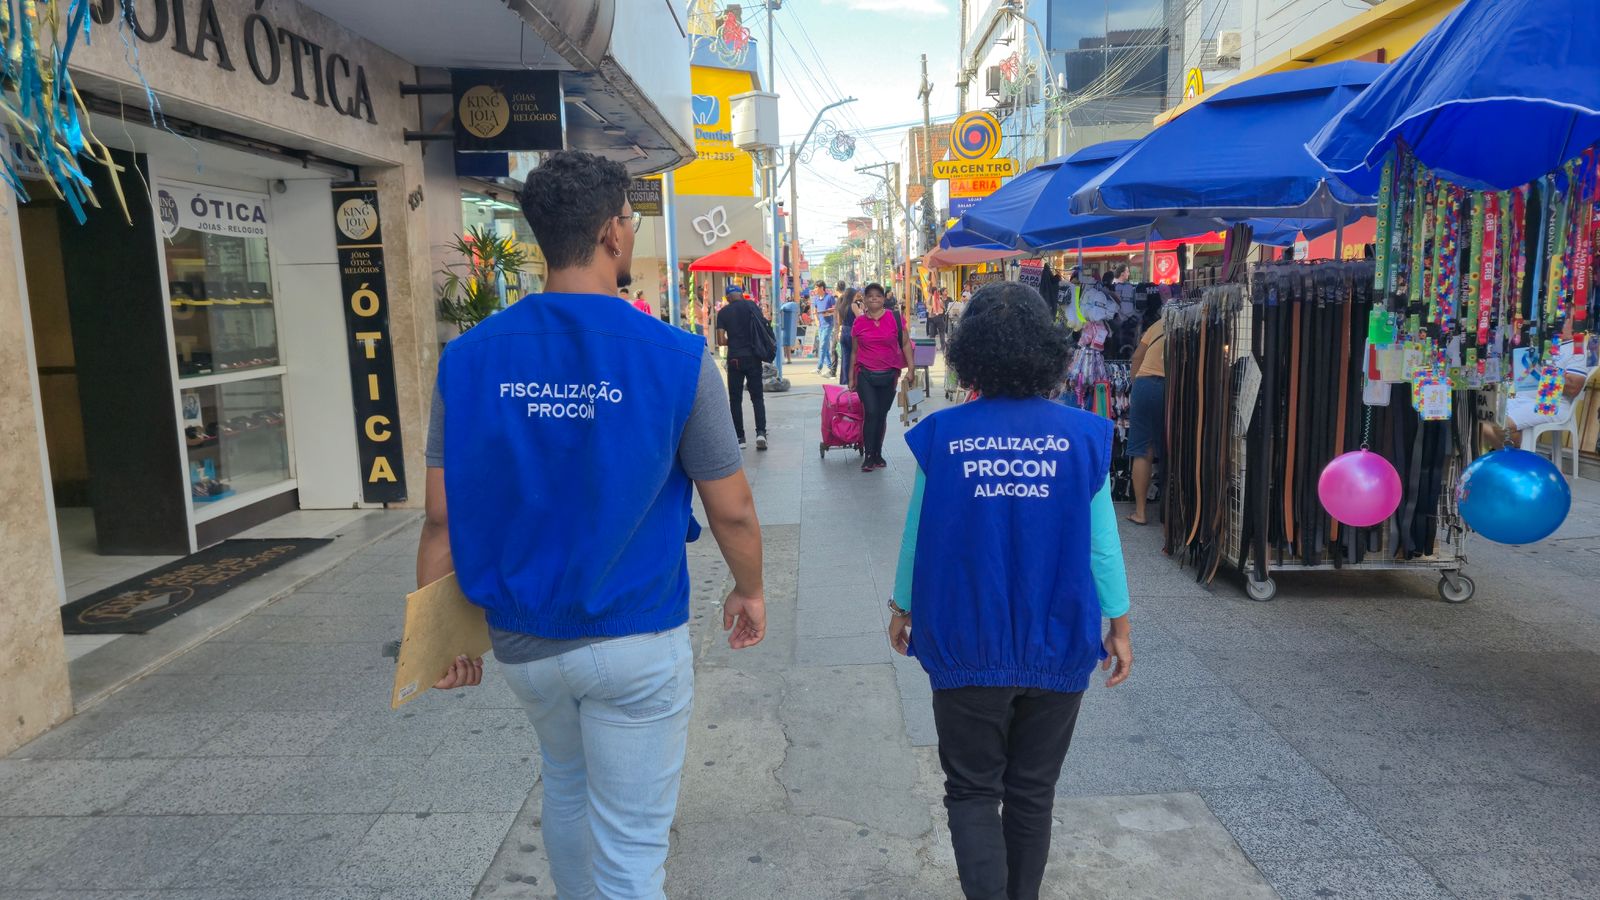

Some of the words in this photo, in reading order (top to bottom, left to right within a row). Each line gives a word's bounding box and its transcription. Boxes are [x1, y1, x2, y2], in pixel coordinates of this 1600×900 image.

[244, 0, 378, 125] ÓTICA
[466, 93, 500, 108] KING
[512, 92, 536, 102] JÓIAS
[512, 101, 539, 112] ÓTICA
[468, 105, 500, 128] JÓIA
[513, 110, 557, 122] RELÓGIOS
[951, 180, 997, 192] GALERIA
[630, 191, 660, 201] COSTURA
[190, 193, 267, 224] ÓTICA
[343, 205, 370, 217] KING
[197, 222, 222, 232] JOIAS
[228, 224, 265, 236] RELOGIOS
[345, 214, 370, 231] JÓIA
[1485, 212, 1494, 232] CRB
[1546, 217, 1555, 260] HONDA
[351, 251, 370, 260] JÓIAS
[351, 258, 372, 267] ÓTICA
[1579, 248, 1587, 264] SÃO
[345, 265, 380, 275] RELÓGIOS
[1484, 262, 1493, 281] CRB
[1576, 265, 1586, 290] PAULO
[1480, 310, 1489, 329] CRB
[351, 283, 397, 483] ÓTICA
[500, 381, 623, 403] FISCALIZAÇÃO
[527, 403, 595, 419] PROCON
[949, 434, 1070, 455] FISCALIZAÇÃO
[963, 459, 1057, 478] PROCON
[974, 483, 1050, 498] ALAGOAS
